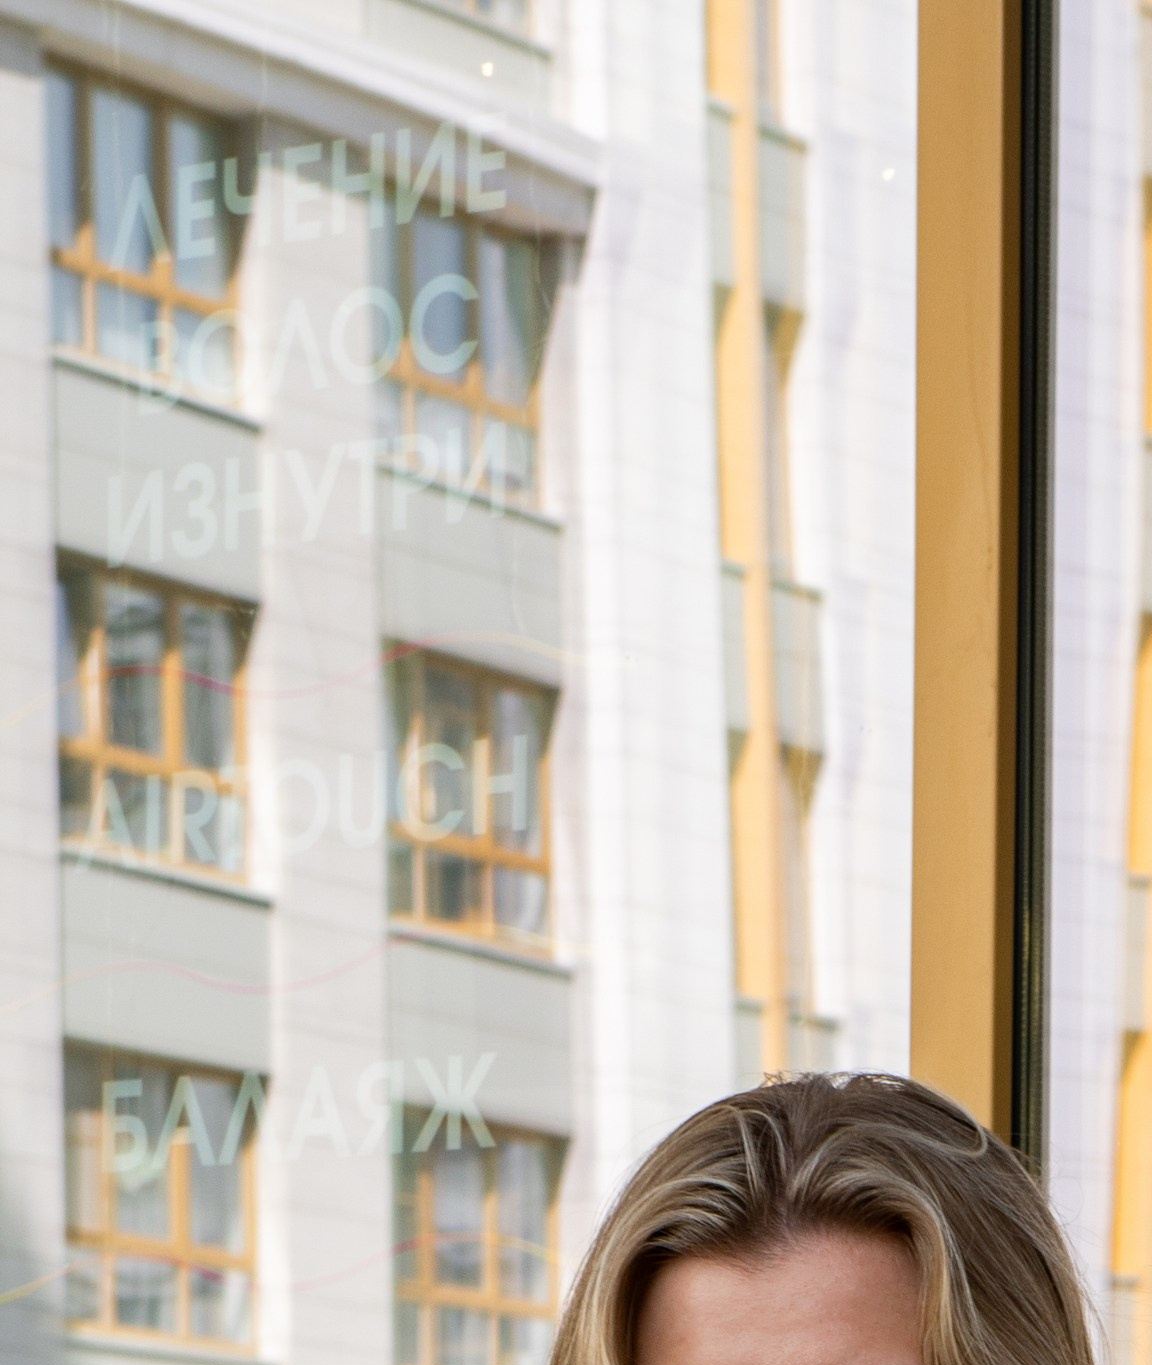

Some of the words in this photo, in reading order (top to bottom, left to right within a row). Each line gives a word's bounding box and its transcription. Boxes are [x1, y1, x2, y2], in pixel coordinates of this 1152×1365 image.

[110, 115, 508, 271] ЛЕЧЕНИЕ
[136, 272, 480, 417] ВОЛОС
[106, 420, 506, 569] ИЗНУТРИ
[75, 735, 529, 873] AIRTOUCH
[101, 1051, 498, 1174] БАЛАЯЖ
